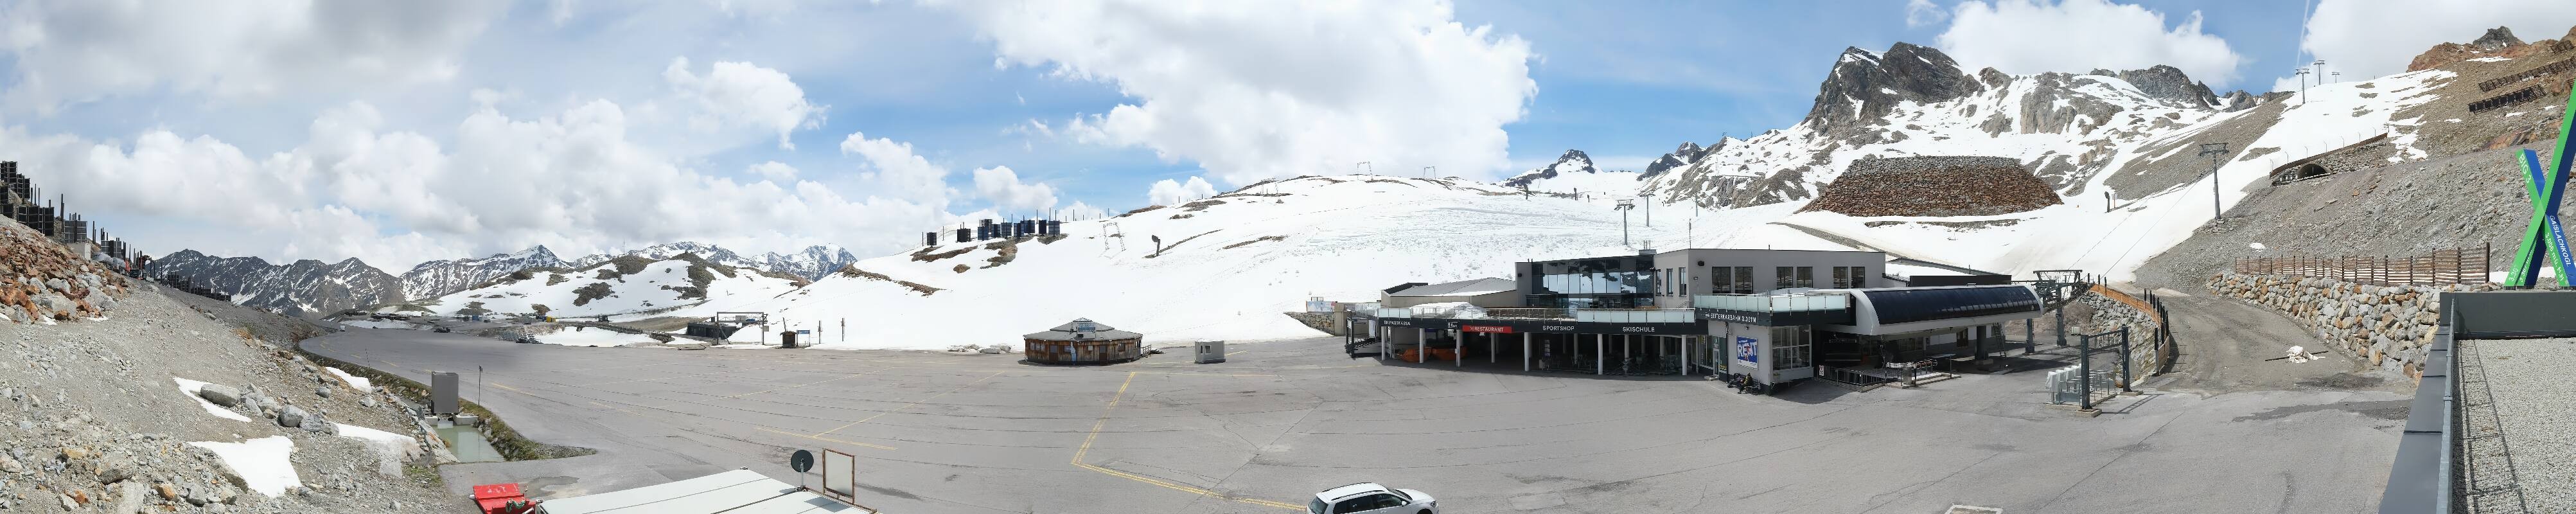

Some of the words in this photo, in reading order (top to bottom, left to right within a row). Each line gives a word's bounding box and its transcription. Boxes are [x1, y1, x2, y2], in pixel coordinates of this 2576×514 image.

[2519, 153, 2528, 174] BIG
[2526, 175, 2532, 183] 3
[2550, 215, 2572, 267] GAISLACHKOGL
